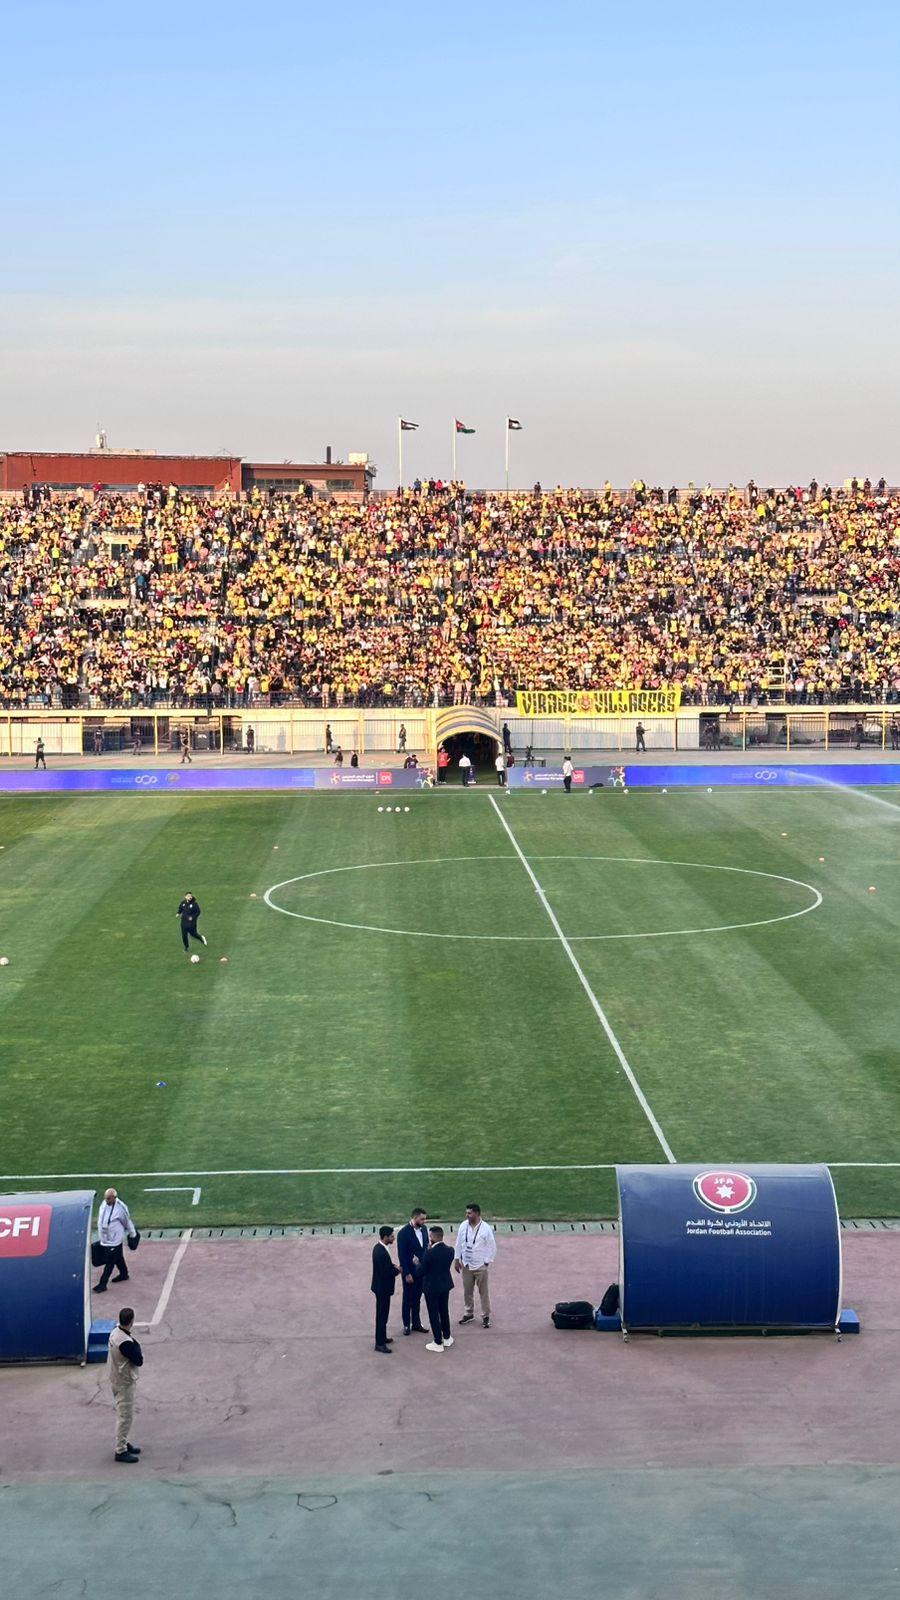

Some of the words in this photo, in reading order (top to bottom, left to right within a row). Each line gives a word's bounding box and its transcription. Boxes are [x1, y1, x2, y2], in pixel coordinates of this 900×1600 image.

[522, 692, 577, 714] VIRAGE
[594, 691, 676, 713] VILLAGERS
[0, 1216, 41, 1237] CFI
[686, 1219, 705, 1227] القدم
[707, 1219, 723, 1227] لكرة
[724, 1219, 748, 1228] الأردني
